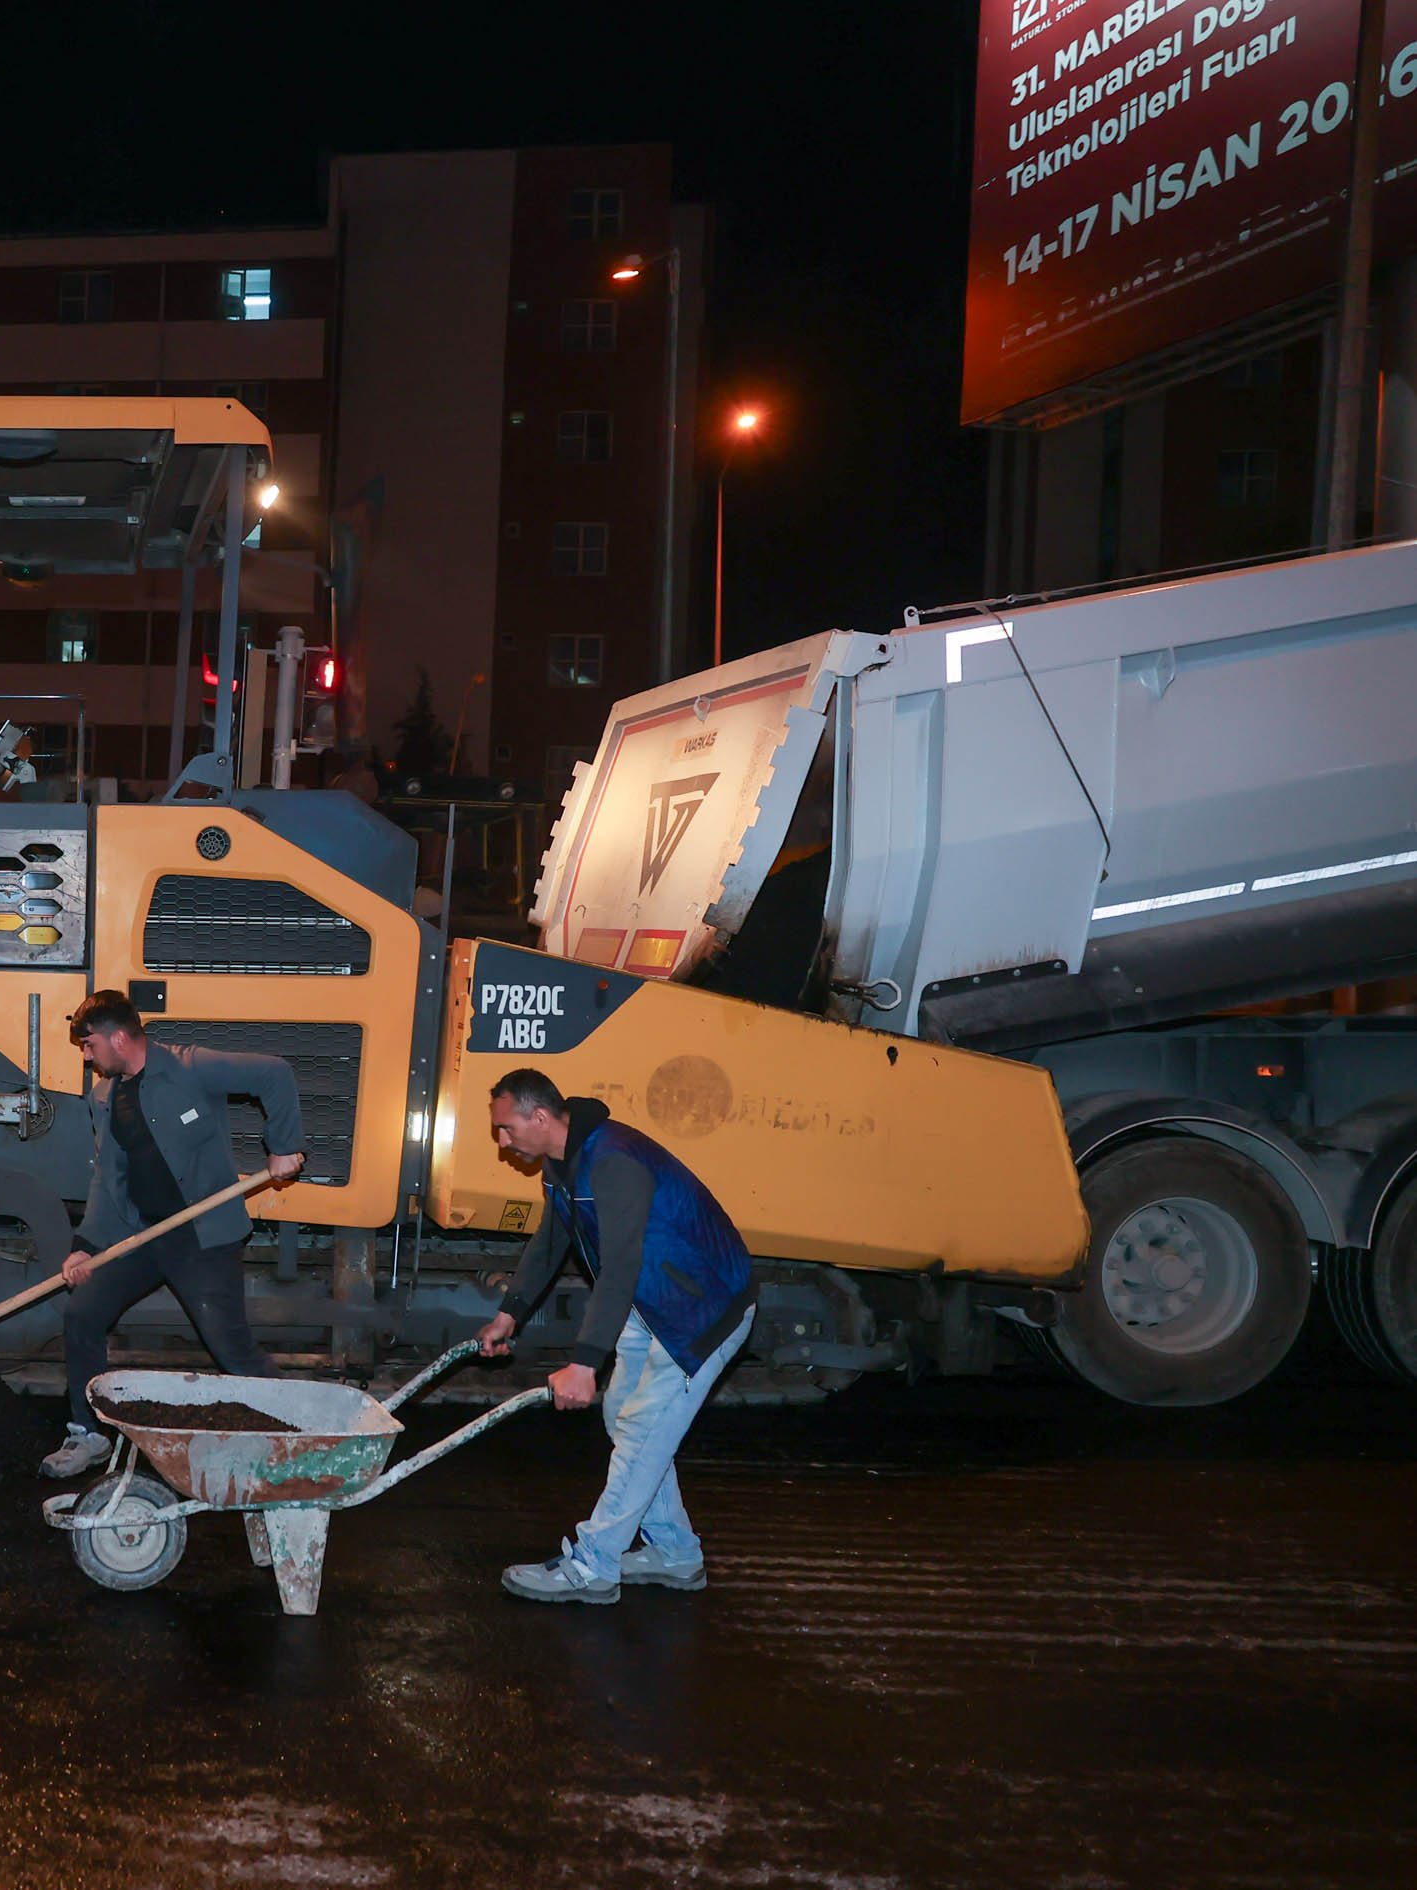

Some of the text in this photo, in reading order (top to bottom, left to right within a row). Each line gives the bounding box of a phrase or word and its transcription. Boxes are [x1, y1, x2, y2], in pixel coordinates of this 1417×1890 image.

[1011, 18, 1053, 50] NATURAL
[1008, 30, 1183, 151] Uluslararası
[1010, 65, 1046, 106] 31.
[1006, 16, 1296, 197] Teknolojileri Fuarı
[1003, 203, 1100, 286] 14-17
[1110, 121, 1261, 236] NİSAN
[1276, 41, 1417, 156] 206
[482, 984, 565, 1016] P7820C
[497, 1019, 546, 1049] ABG
